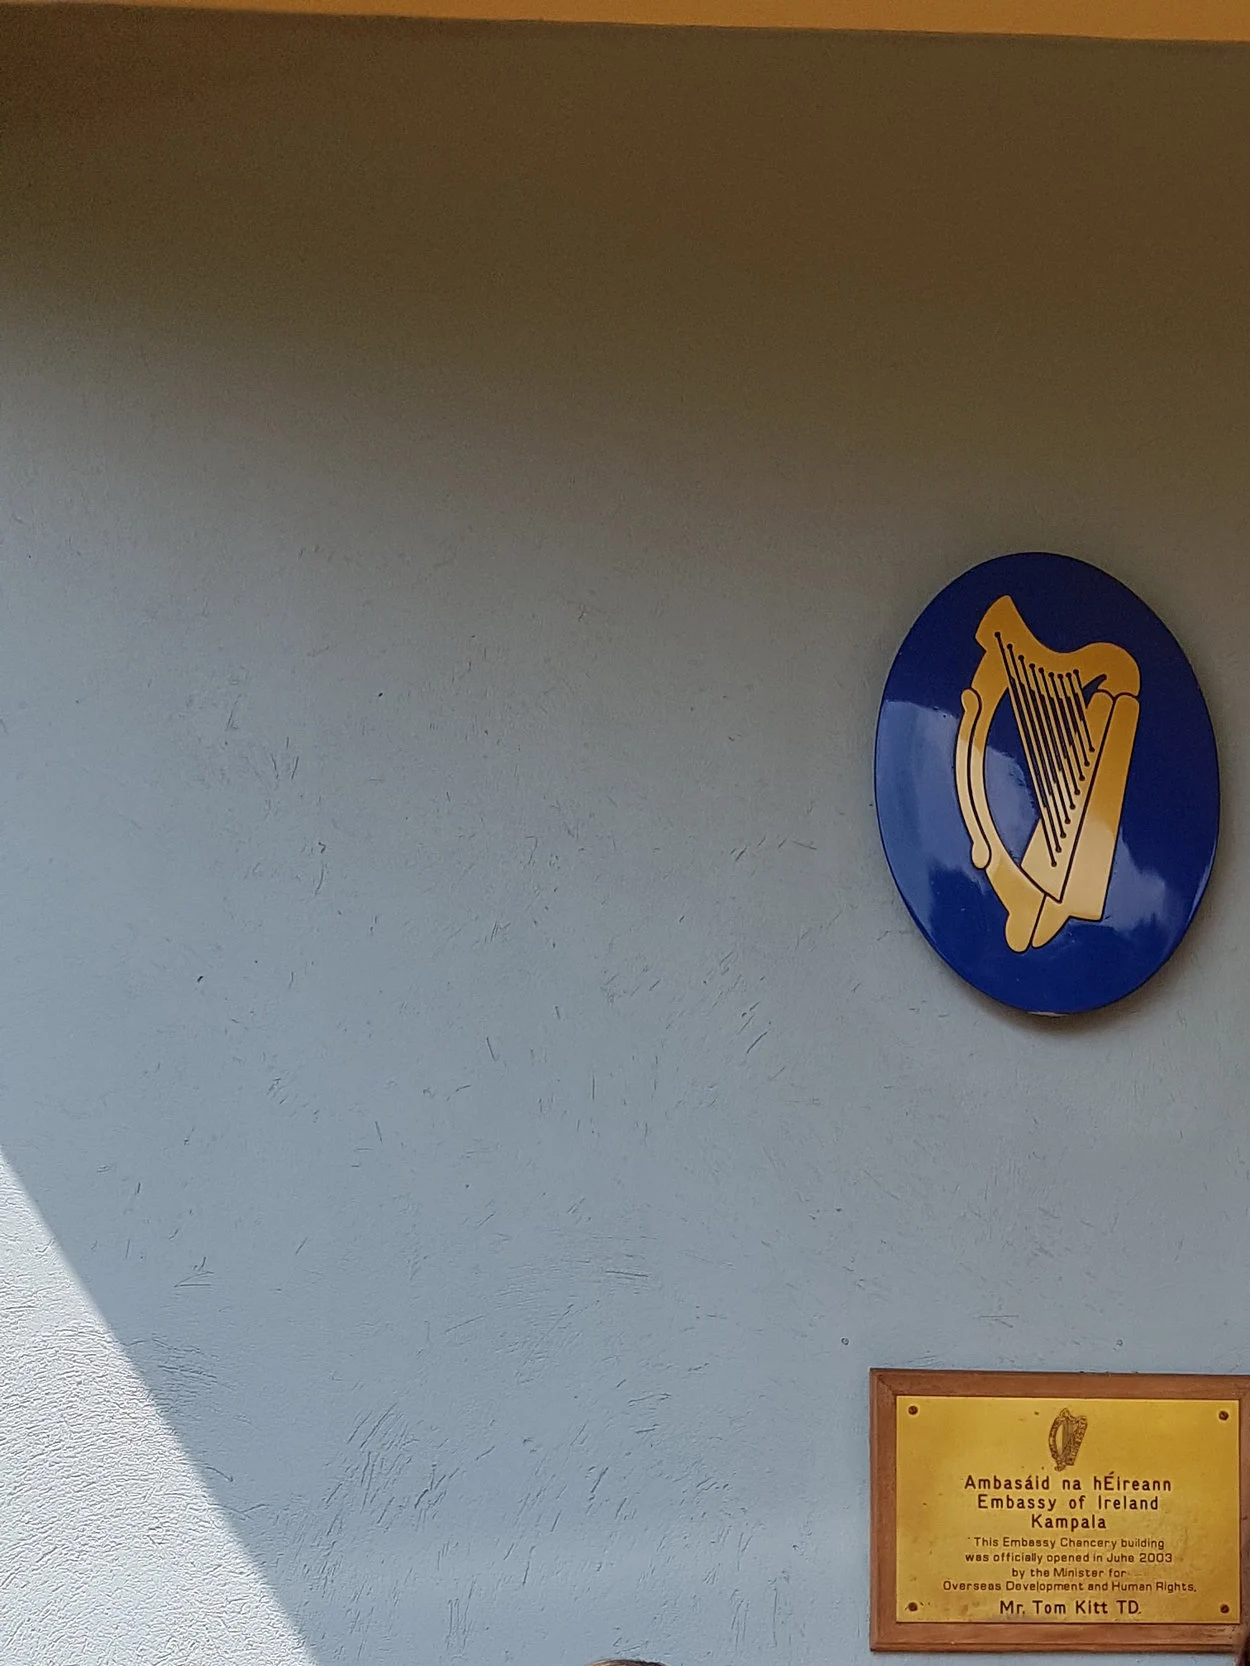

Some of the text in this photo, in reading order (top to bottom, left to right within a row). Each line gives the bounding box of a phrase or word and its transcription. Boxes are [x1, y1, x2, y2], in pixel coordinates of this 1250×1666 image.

[964, 1471, 1172, 1491] Ambasáid na hÉireann
[978, 1494, 1158, 1511] Embassy of Ireland
[1032, 1514, 1106, 1532] Kampala
[974, 1537, 1165, 1550] This Embassy Chancery building
[965, 1554, 989, 1562] was
[993, 1553, 1043, 1564] officially
[1047, 1553, 1089, 1565] opened
[1093, 1553, 1103, 1562] in
[1140, 1553, 1172, 1563] 2003
[1012, 1568, 1126, 1579] by the Minister for
[943, 1581, 1002, 1591] Overseas
[1006, 1581, 1084, 1593] Development
[1088, 1582, 1108, 1591] and
[1112, 1582, 1152, 1592] Human
[1000, 1600, 1025, 1614] Mr.
[1033, 1601, 1066, 1614] Tom
[1076, 1600, 1108, 1614] Kitt
